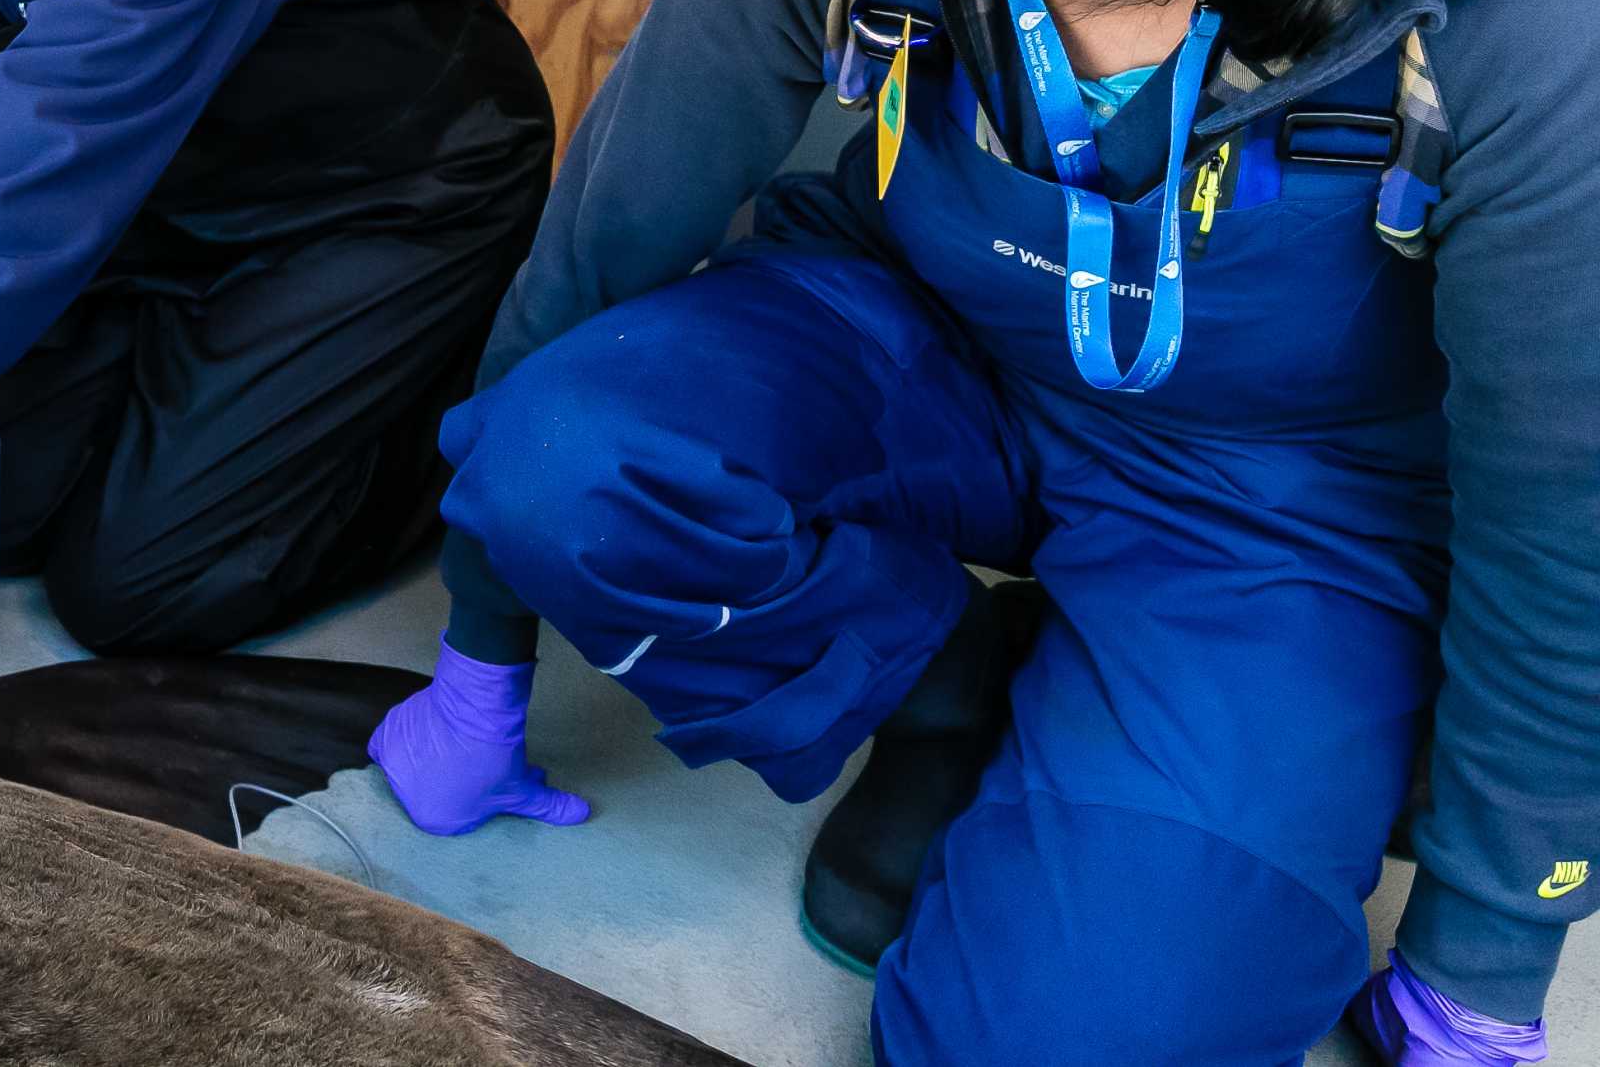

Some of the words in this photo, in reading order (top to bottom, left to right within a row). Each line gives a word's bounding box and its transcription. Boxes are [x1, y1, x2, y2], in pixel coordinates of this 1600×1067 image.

[1024, 32, 1037, 66] Mammal
[1033, 29, 1043, 45] The
[1037, 45, 1052, 72] Marine
[1019, 247, 1067, 277] Wes
[1109, 281, 1153, 301] arin
[1071, 291, 1080, 326] Mammal
[1081, 291, 1090, 306] The
[1081, 307, 1091, 336] Marine
[1551, 860, 1589, 883] NIKE
